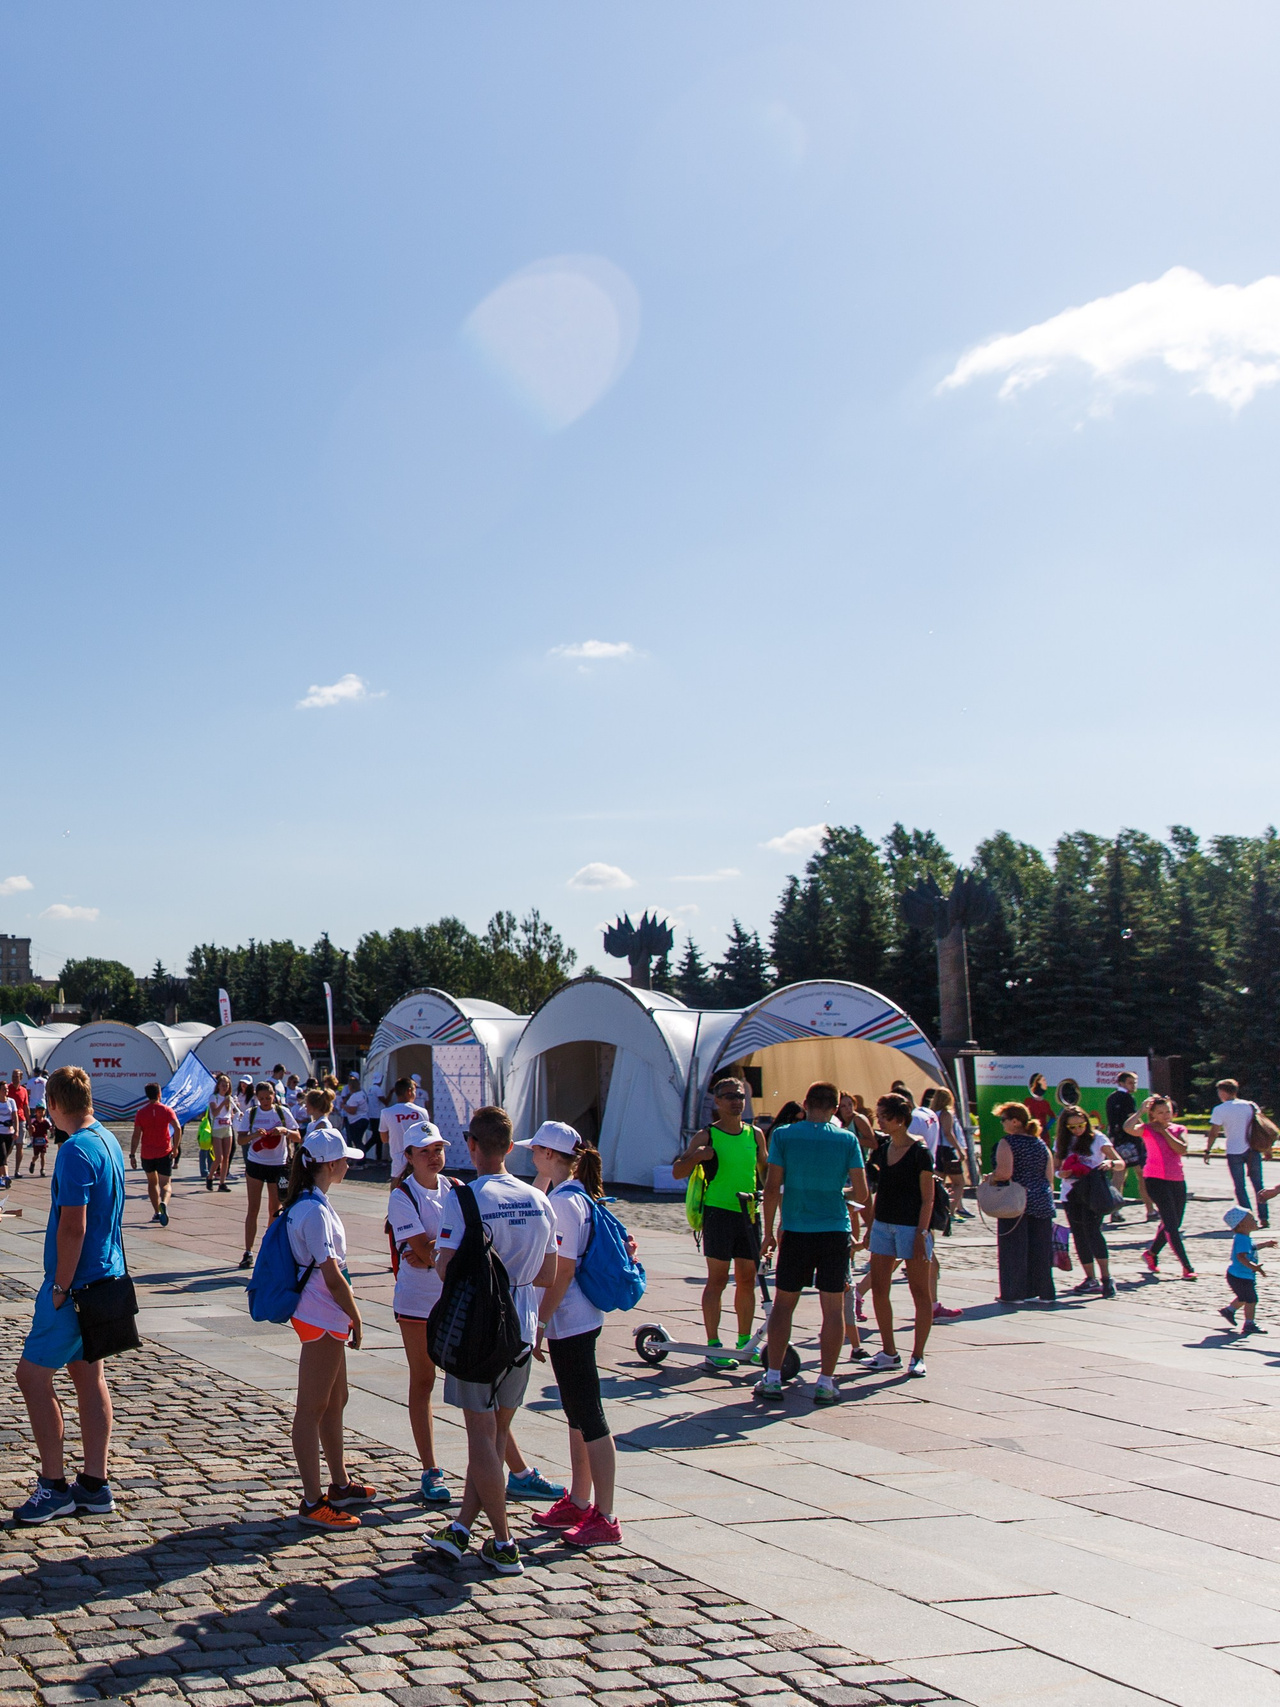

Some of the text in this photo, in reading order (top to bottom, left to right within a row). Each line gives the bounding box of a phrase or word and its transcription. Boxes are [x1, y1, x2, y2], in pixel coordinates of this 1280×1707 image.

[93, 1057, 122, 1068] ТТК
[233, 1056, 261, 1067] ТТК
[395, 1111, 420, 1123] РЖД
[498, 1201, 532, 1210] РОССИЙСКИЙ
[481, 1211, 516, 1221] УНИВЕРСИТЕТ
